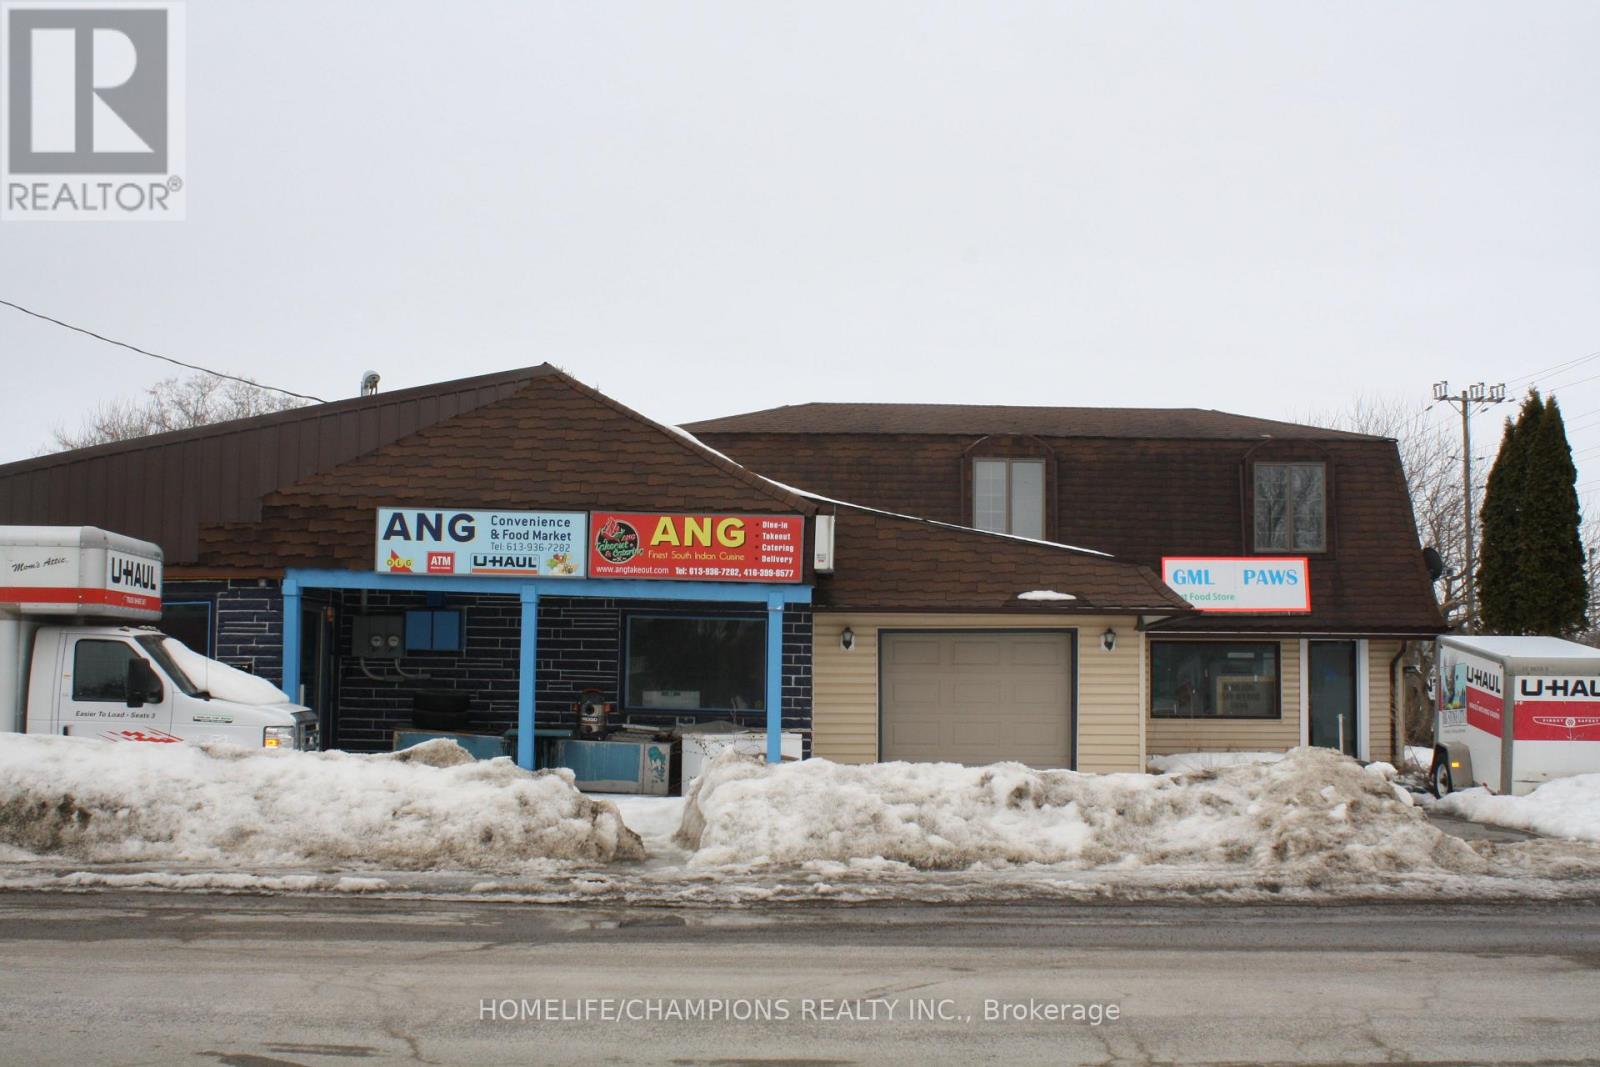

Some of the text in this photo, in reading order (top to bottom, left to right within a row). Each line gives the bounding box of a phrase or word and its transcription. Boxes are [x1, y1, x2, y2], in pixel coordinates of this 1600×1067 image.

[491, 515, 571, 527] Convenience
[762, 521, 788, 529] Dine-in
[382, 512, 475, 542] ANG
[650, 516, 746, 547] ANG
[490, 529, 571, 541] & Food Market
[762, 532, 791, 540] Takeout
[506, 543, 571, 552] 613-936-7282
[762, 544, 794, 553] Catering
[431, 556, 451, 566] ATM
[648, 550, 745, 561] Finest South Indian Cuisine
[761, 555, 793, 564] Delivery
[473, 555, 537, 568] U-HAUL
[111, 556, 156, 591] U-HAUL
[596, 565, 669, 574] www.angtakeout.com
[675, 567, 687, 575] Tel:
[1173, 568, 1299, 586] GML PAWS
[1190, 592, 1211, 601] Food
[1212, 592, 1235, 601] Store
[1466, 665, 1501, 694] U-HAUL
[1521, 679, 1600, 697] U-HAU
